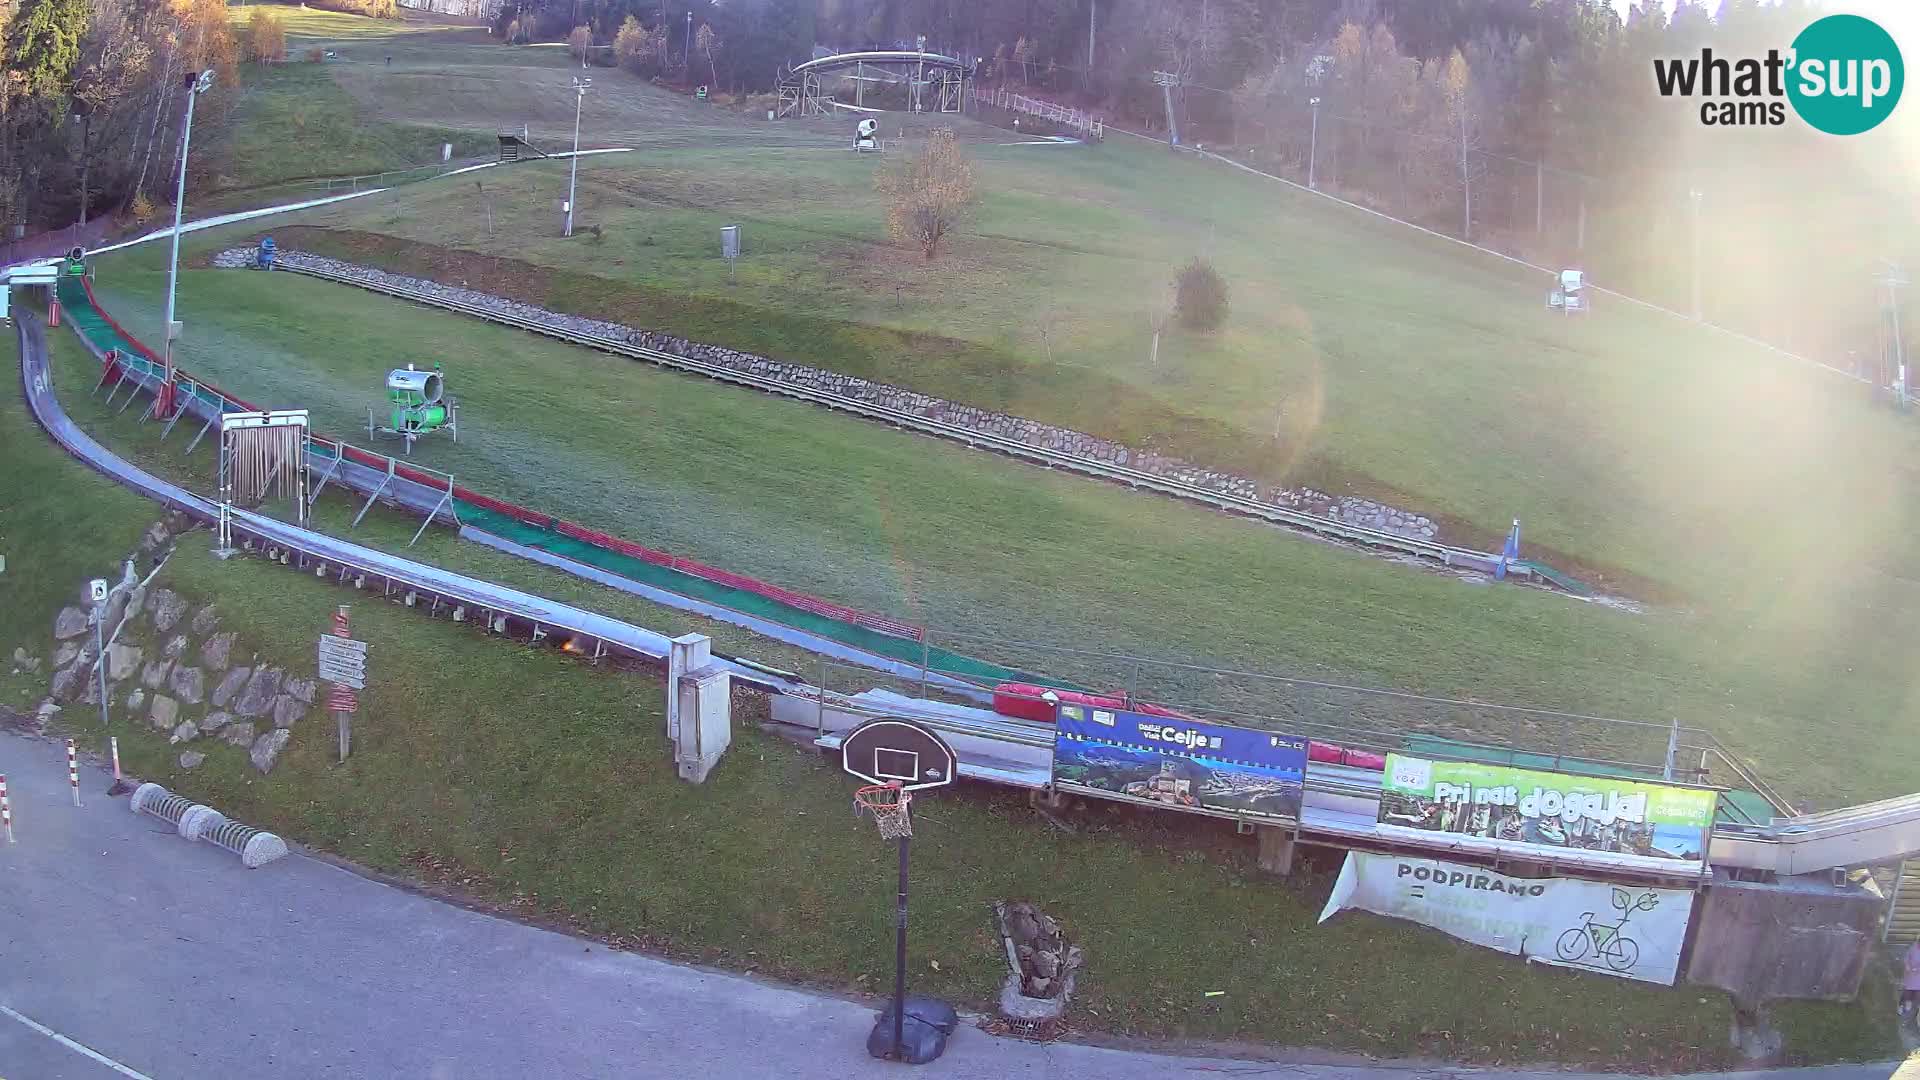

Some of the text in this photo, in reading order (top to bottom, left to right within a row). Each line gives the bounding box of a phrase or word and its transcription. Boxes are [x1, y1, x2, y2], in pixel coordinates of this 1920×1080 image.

[1161, 727, 1207, 748] Celje
[1434, 782, 1471, 804] Pri
[1475, 785, 1518, 806] nas
[1398, 863, 1545, 897] PODPIRAMO
